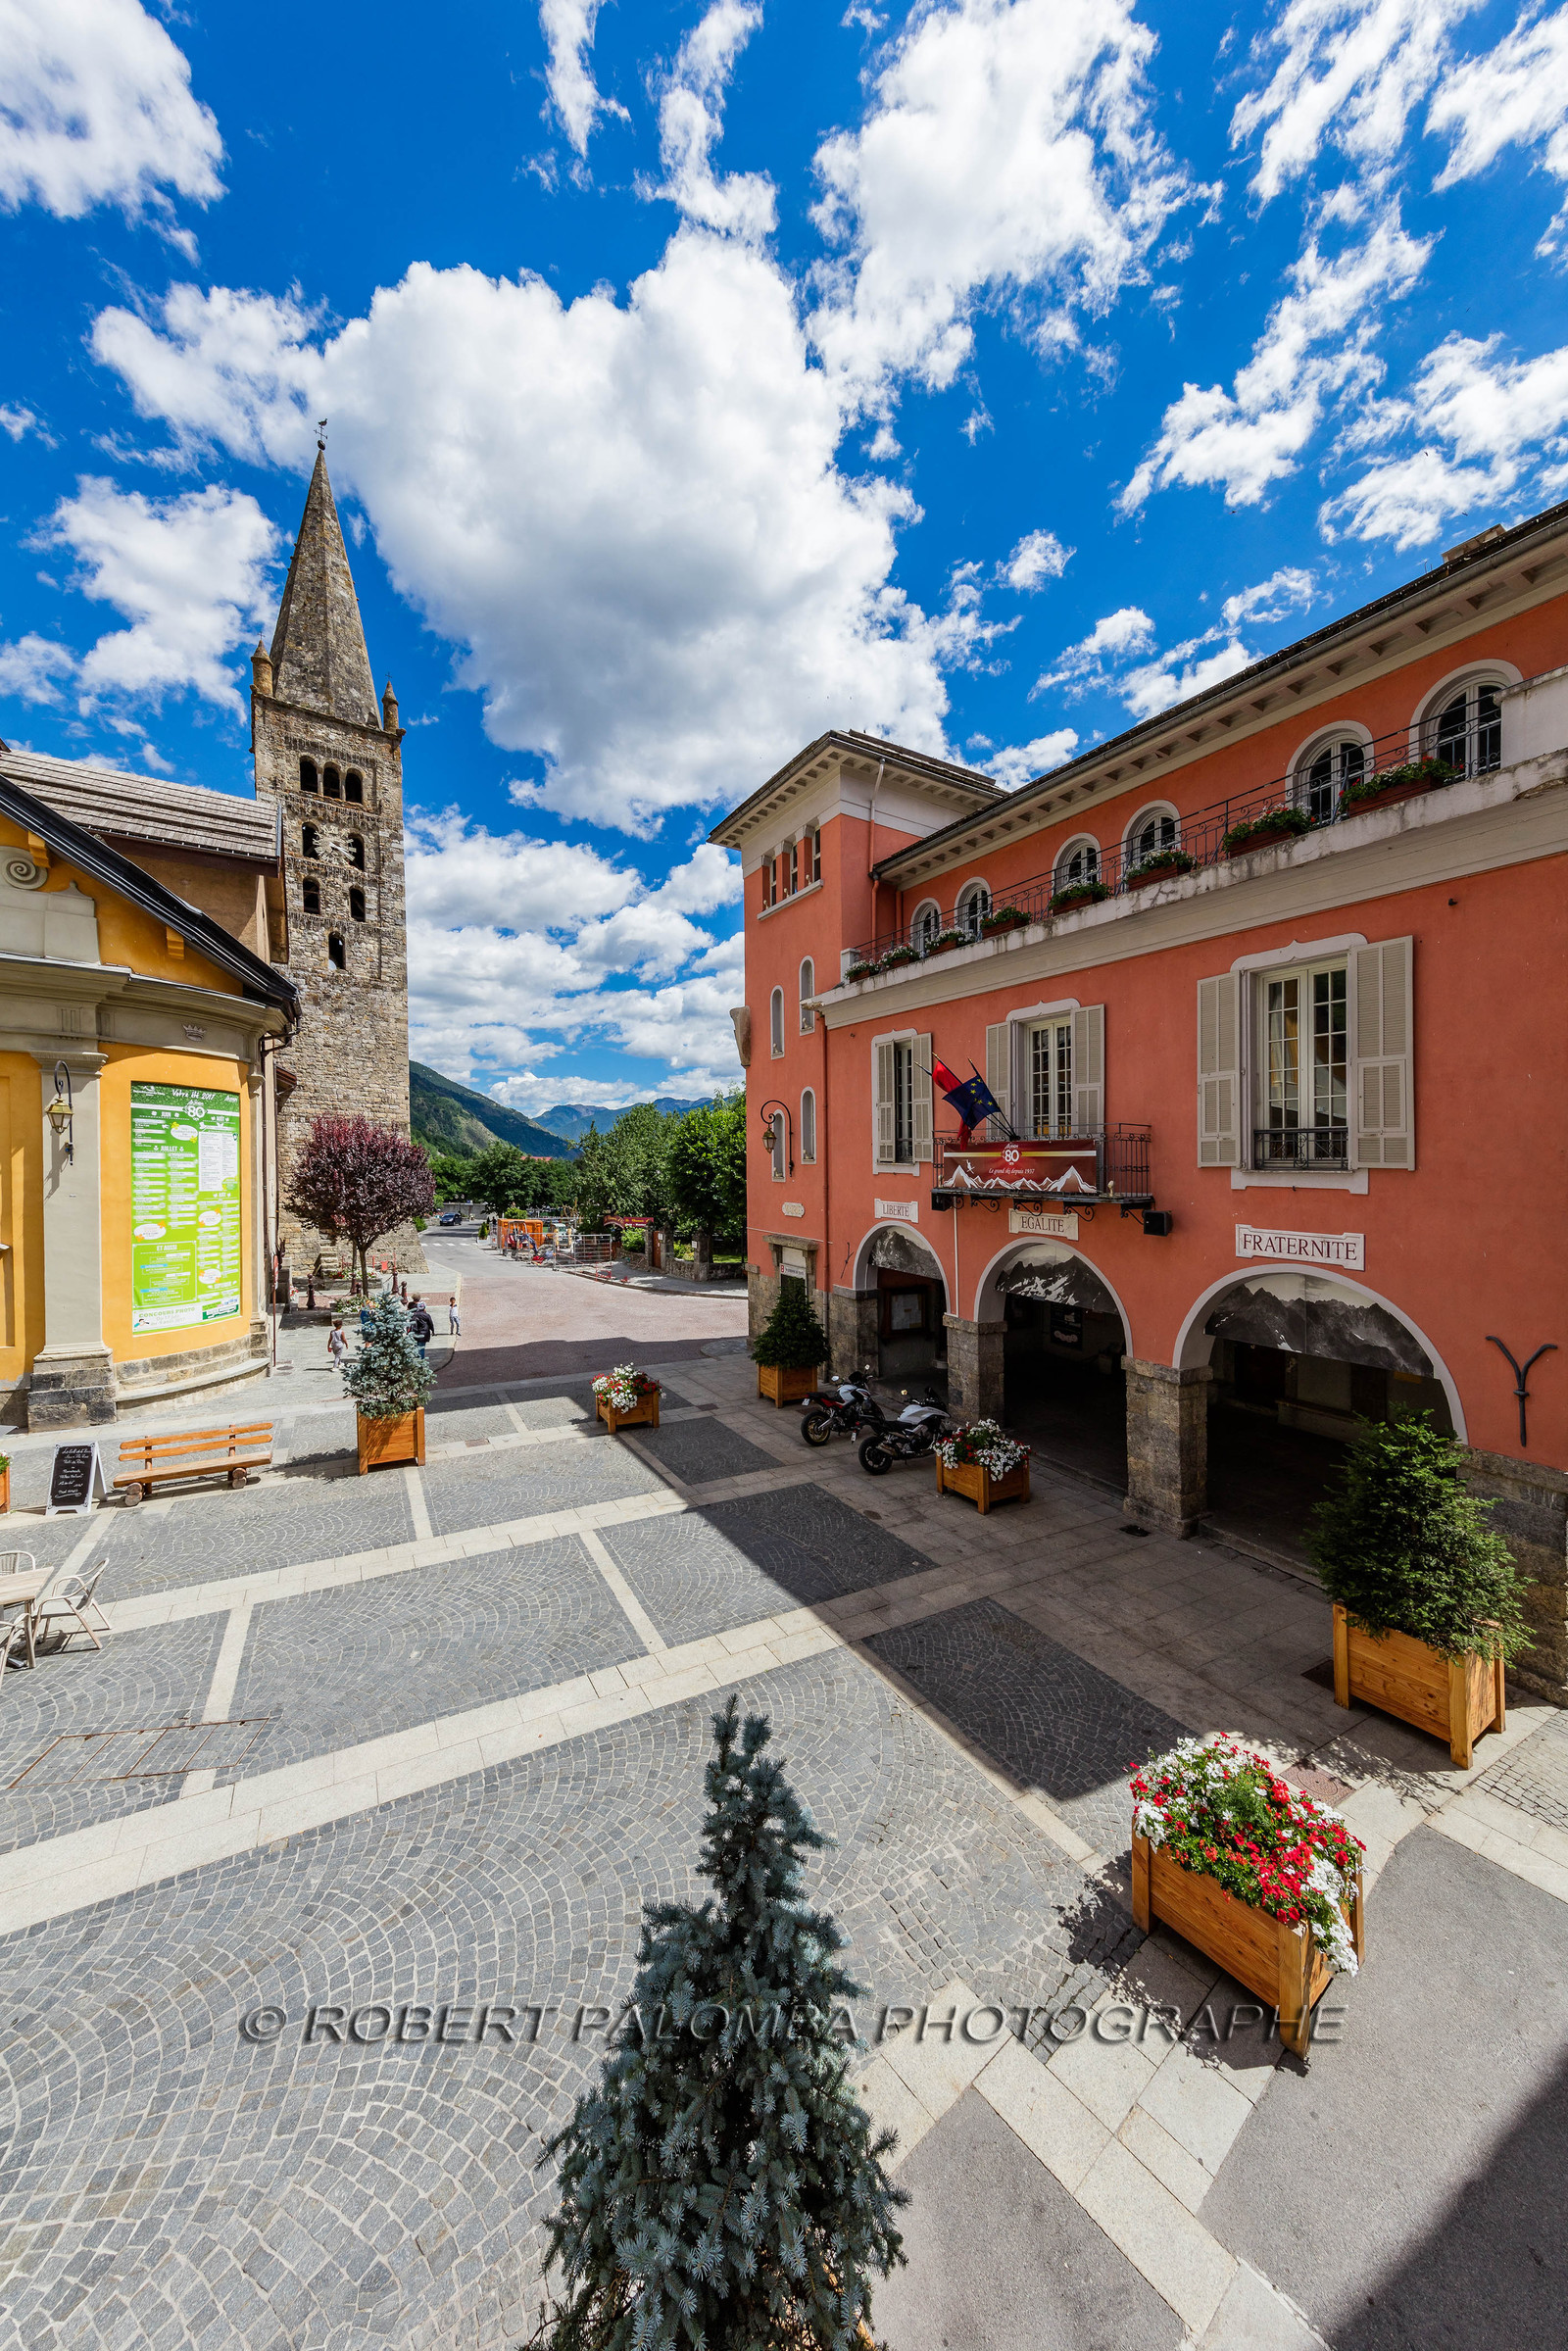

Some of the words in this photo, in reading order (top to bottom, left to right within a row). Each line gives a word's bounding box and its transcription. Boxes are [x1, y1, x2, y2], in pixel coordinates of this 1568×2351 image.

[172, 1088, 188, 1098] Votre
[187, 1105, 205, 1118] 80
[1004, 1150, 1019, 1162] 80
[882, 1203, 909, 1217] LIBERTE
[1020, 1215, 1064, 1233] EGALITE
[1243, 1233, 1357, 1261] FRATERNITE
[138, 1309, 174, 1318] CONCOURS
[174, 1306, 196, 1315] PHOTO
